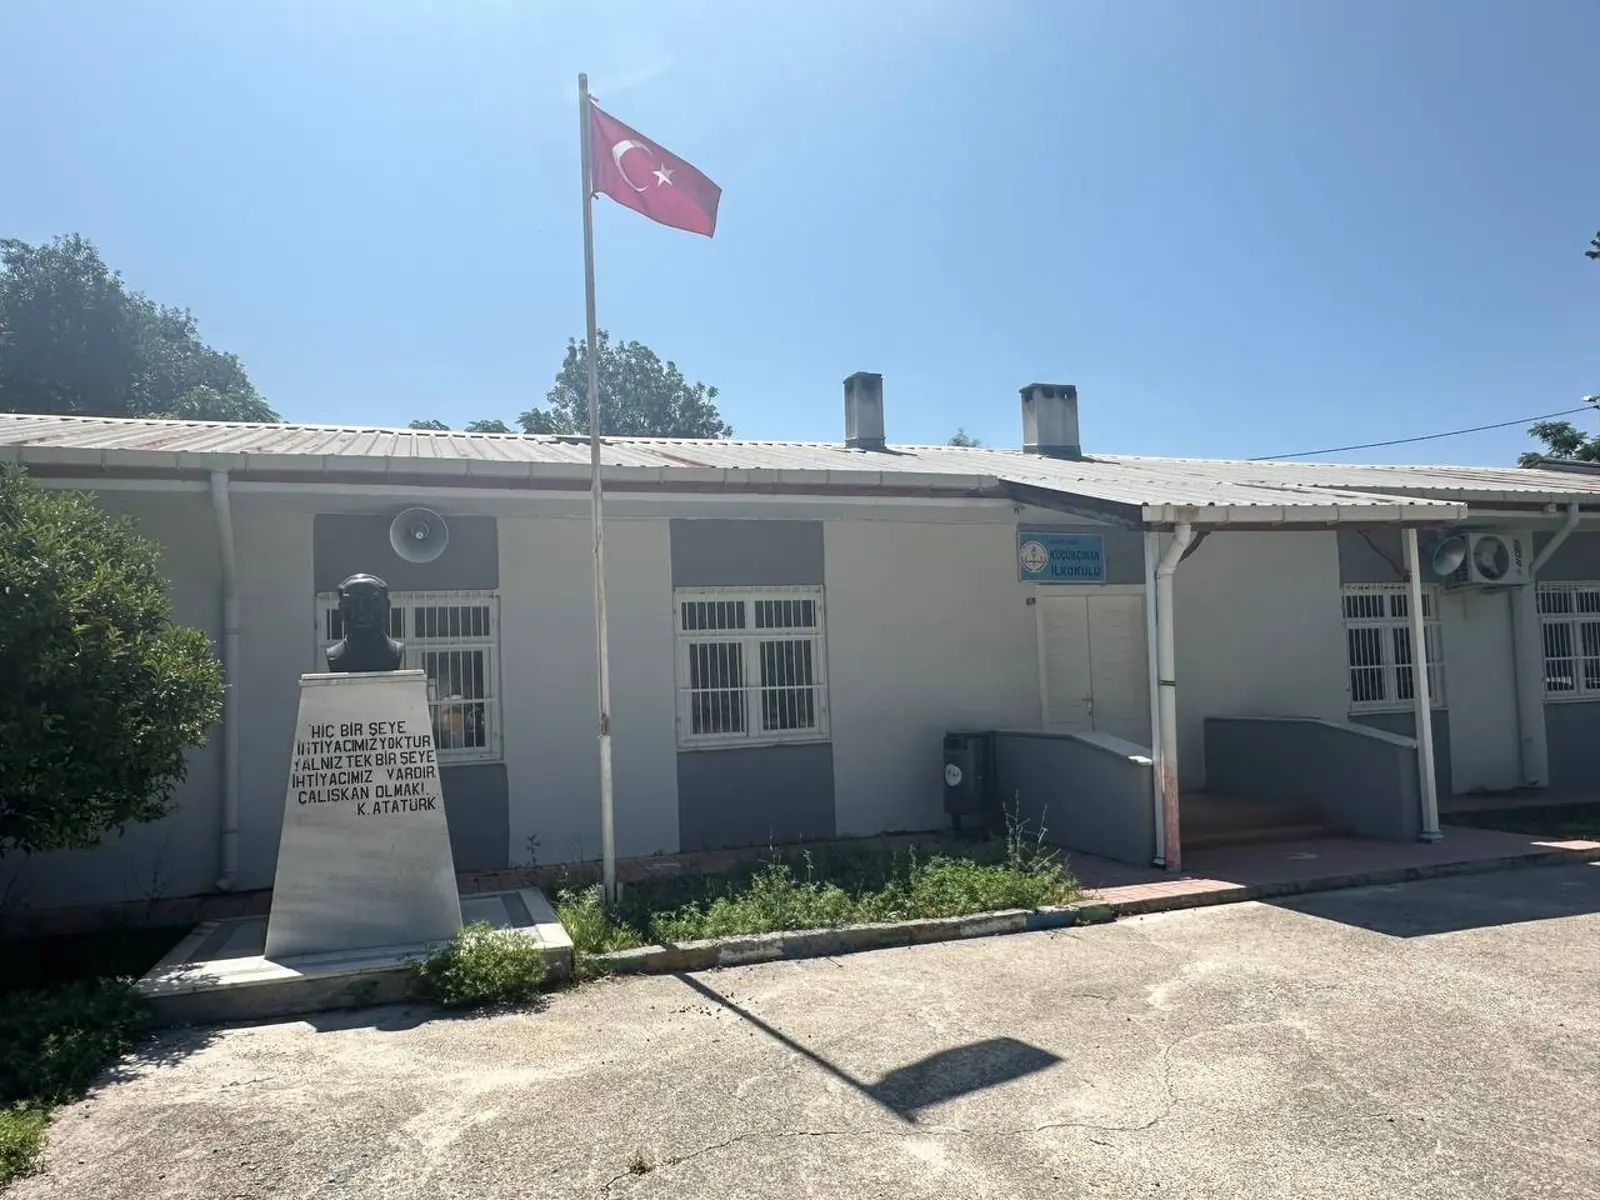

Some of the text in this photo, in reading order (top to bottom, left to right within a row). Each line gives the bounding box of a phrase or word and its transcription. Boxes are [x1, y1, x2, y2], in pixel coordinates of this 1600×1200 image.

[340, 721, 363, 737] BİR
[368, 720, 406, 736] ŞEYE
[346, 753, 373, 767] TEK
[375, 750, 397, 766] BİR
[400, 749, 436, 765] ŞEYE
